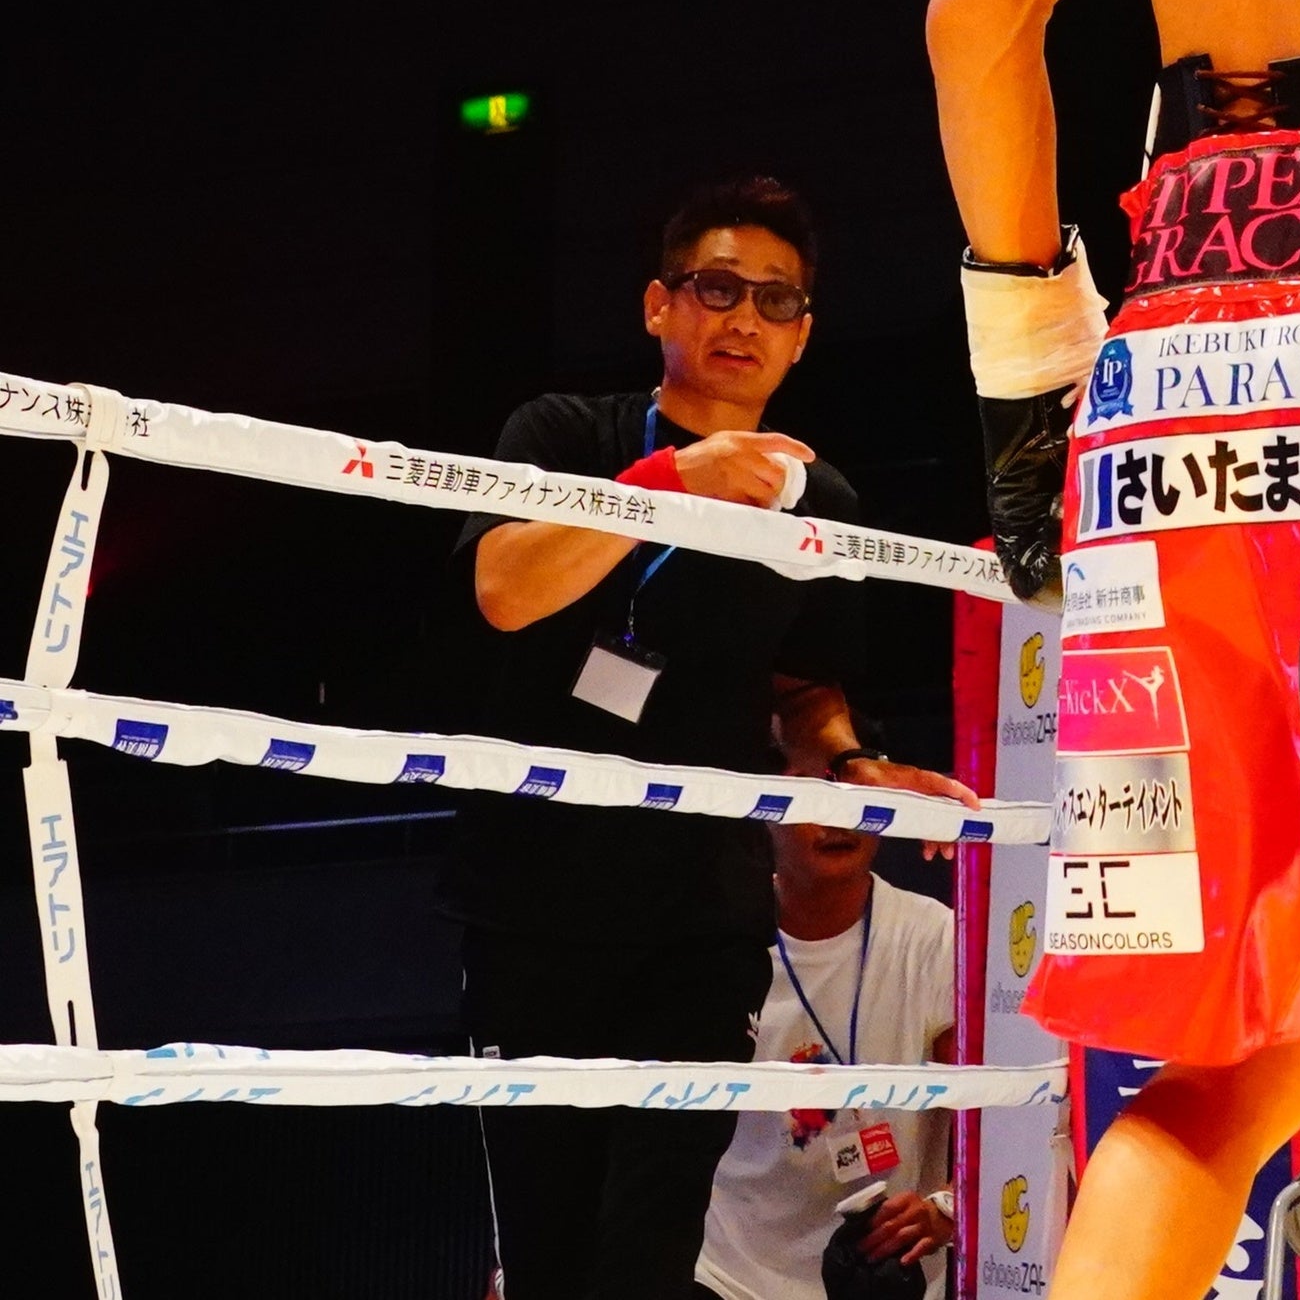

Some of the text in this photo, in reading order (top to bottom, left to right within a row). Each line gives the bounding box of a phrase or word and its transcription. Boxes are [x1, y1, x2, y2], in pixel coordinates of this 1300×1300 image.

[385, 454, 656, 526] 三菱自動車ファイナンス株式会社
[44, 509, 89, 652] エアトリ
[40, 814, 76, 964] エアトリ
[1049, 931, 1174, 950] SEASONCOLORS
